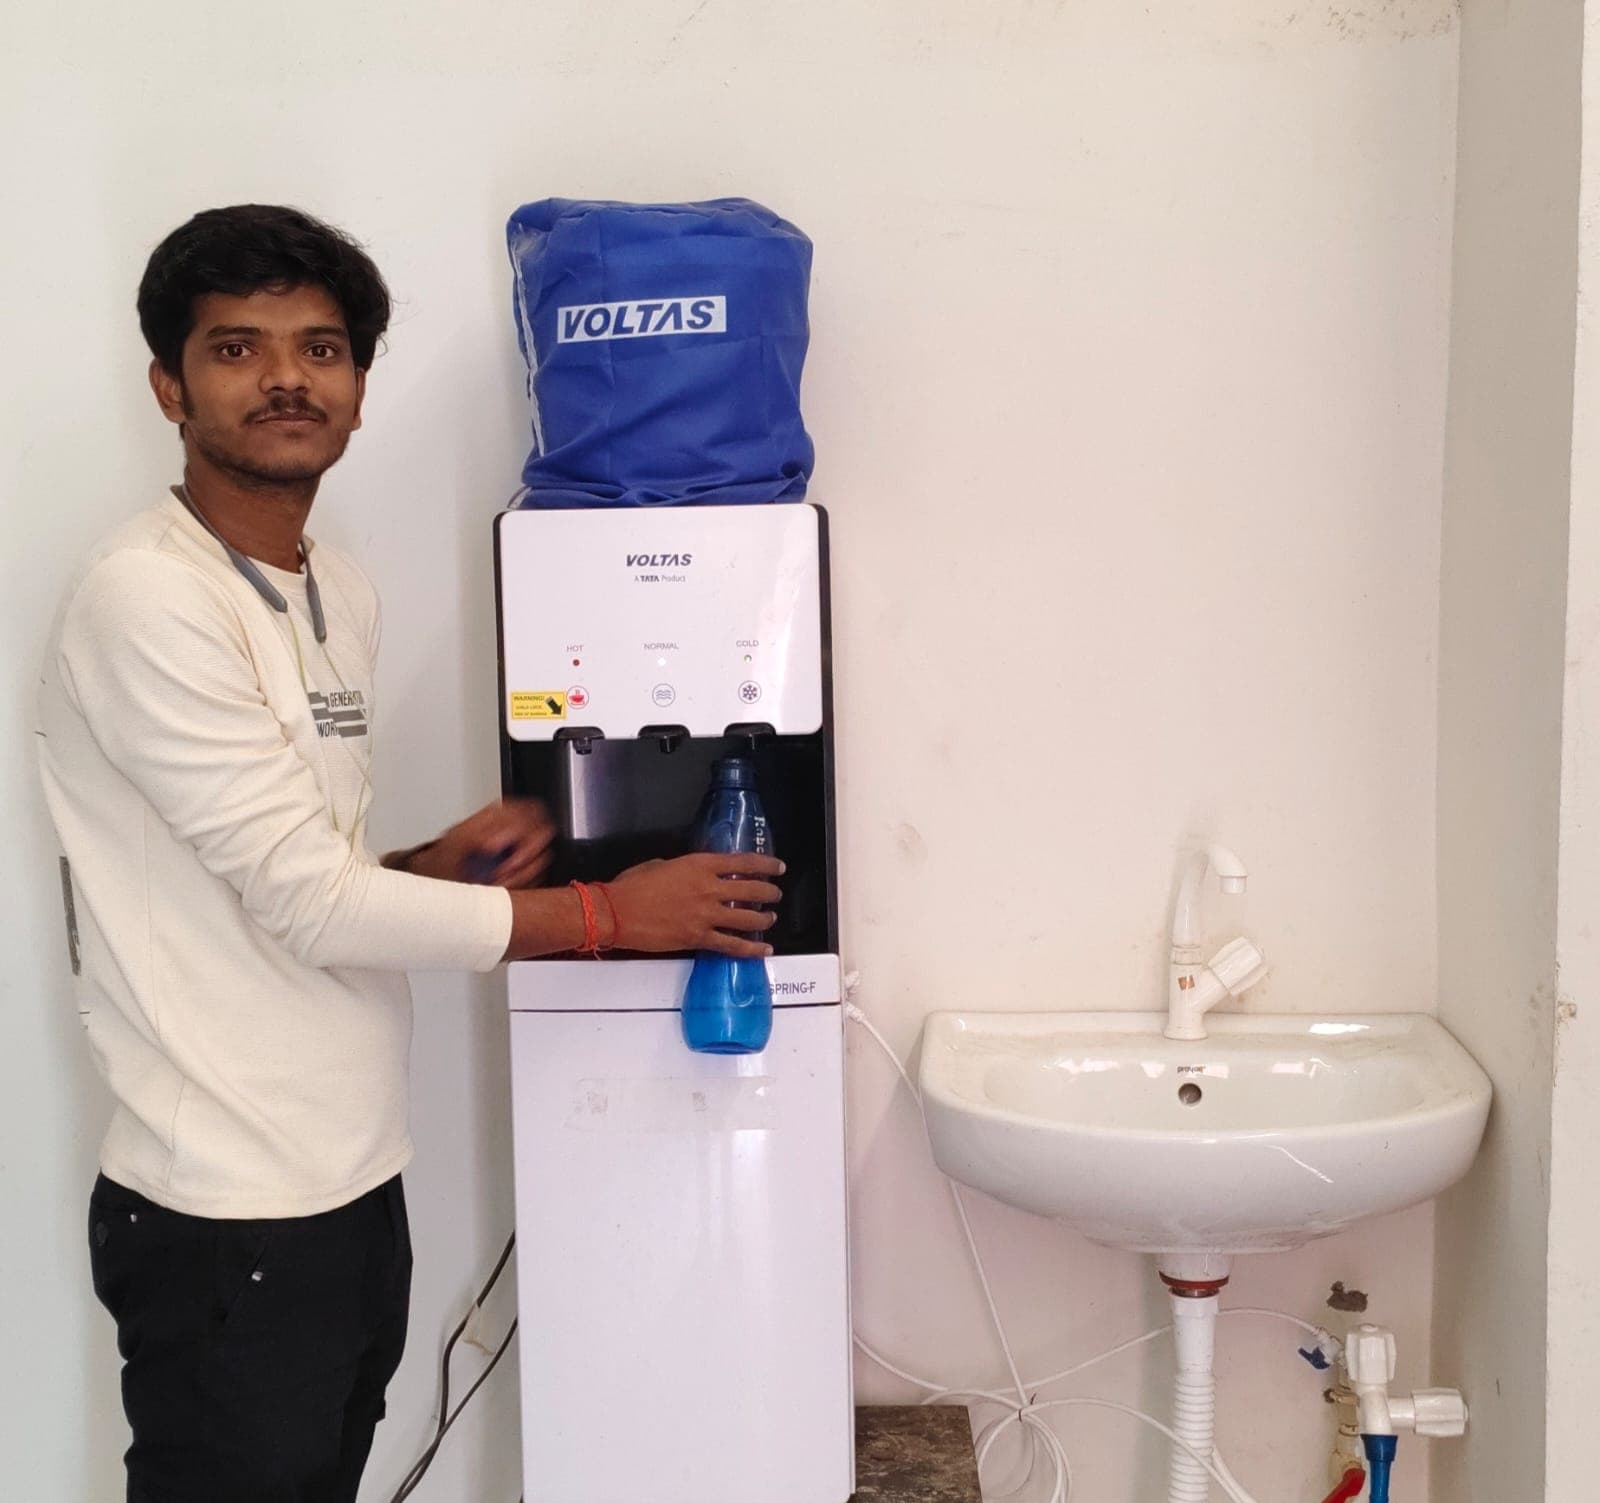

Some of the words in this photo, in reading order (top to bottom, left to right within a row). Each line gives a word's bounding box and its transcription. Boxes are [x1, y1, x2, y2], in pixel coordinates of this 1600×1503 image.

[564, 300, 715, 339] VOLTAS
[626, 553, 693, 567] VOLTAS
[661, 574, 686, 582] Product
[566, 644, 584, 652] HOT
[644, 643, 679, 651] NORMAL
[735, 640, 759, 648] COLD
